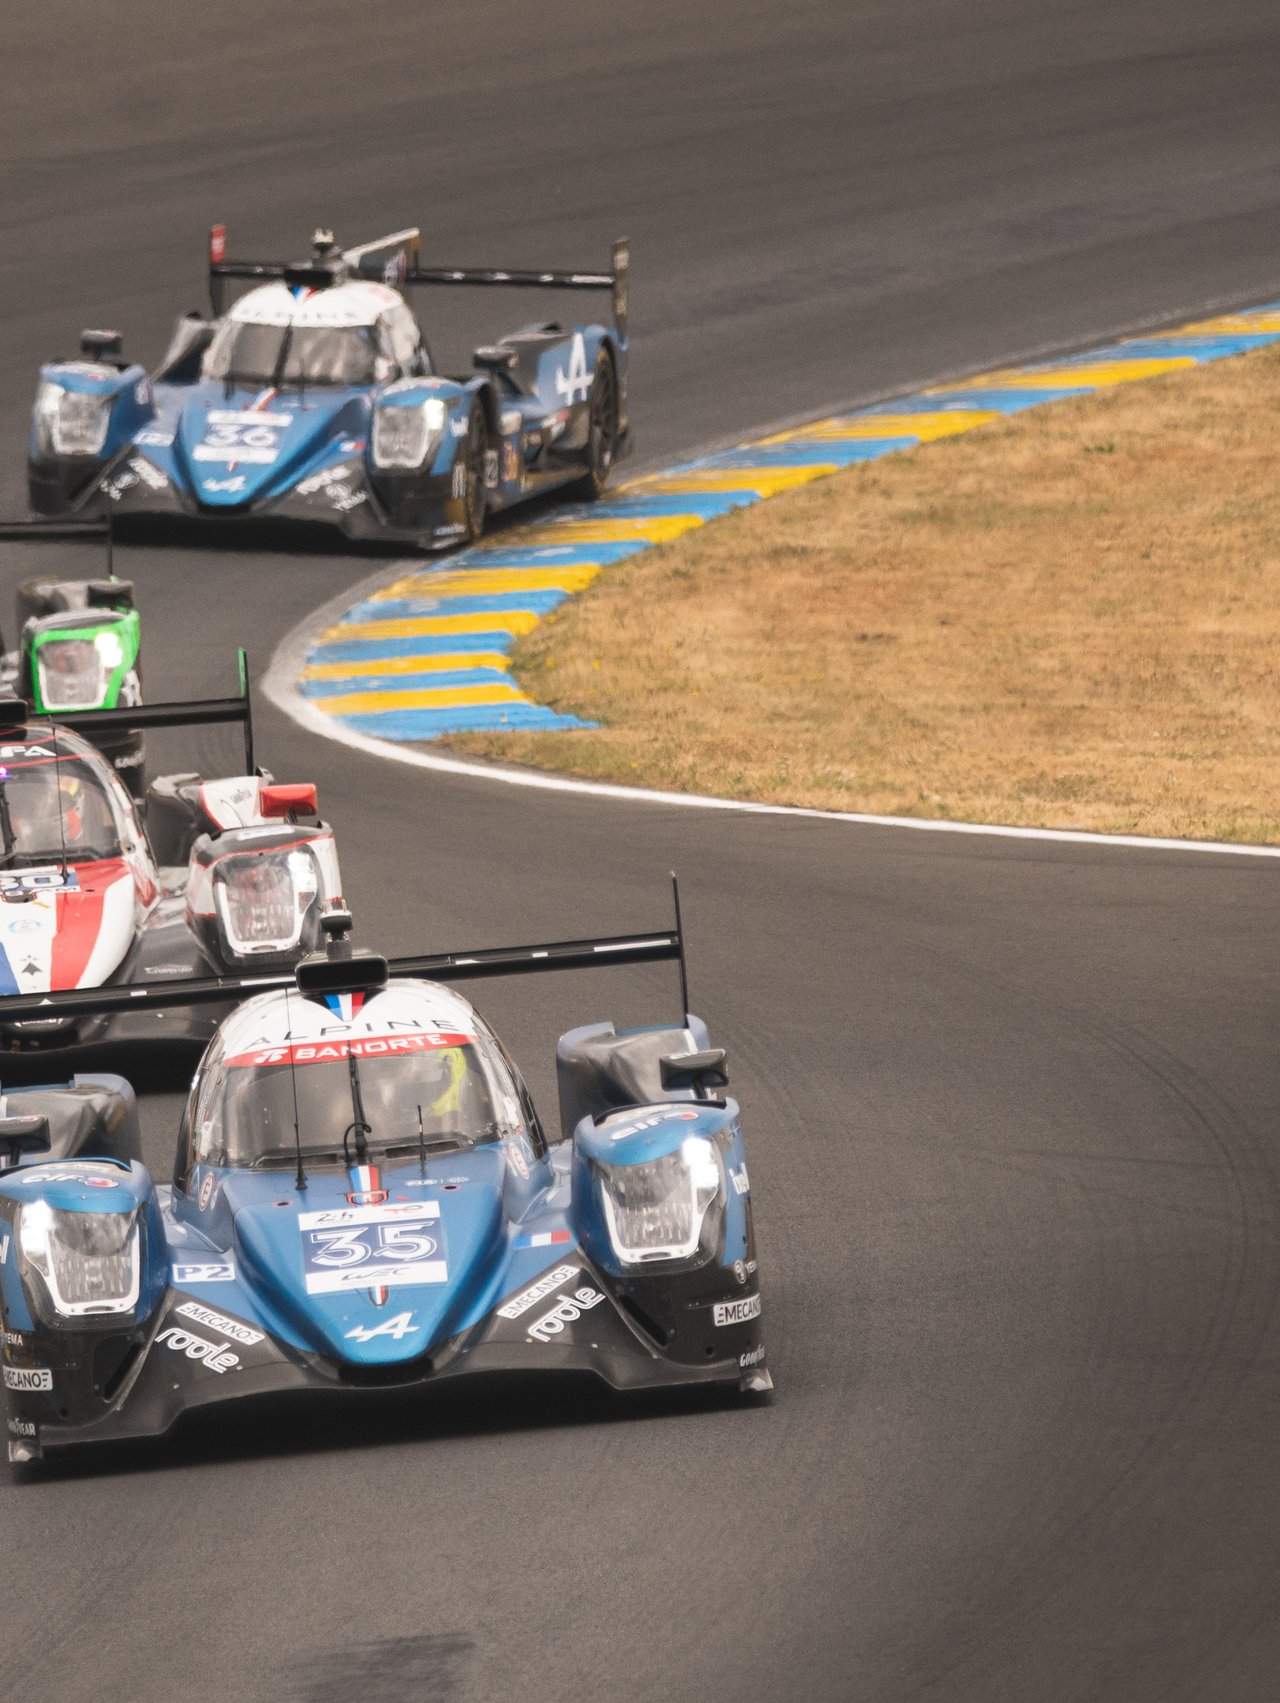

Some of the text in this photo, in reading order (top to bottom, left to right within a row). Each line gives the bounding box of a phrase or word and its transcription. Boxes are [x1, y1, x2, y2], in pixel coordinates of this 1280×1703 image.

[243, 1019, 461, 1051] ALPINE
[295, 1034, 448, 1060] BANORTE
[311, 1221, 437, 1268] 35
[177, 1265, 231, 1280] P2
[528, 1287, 606, 1343] roole
[155, 1327, 240, 1374] roole
